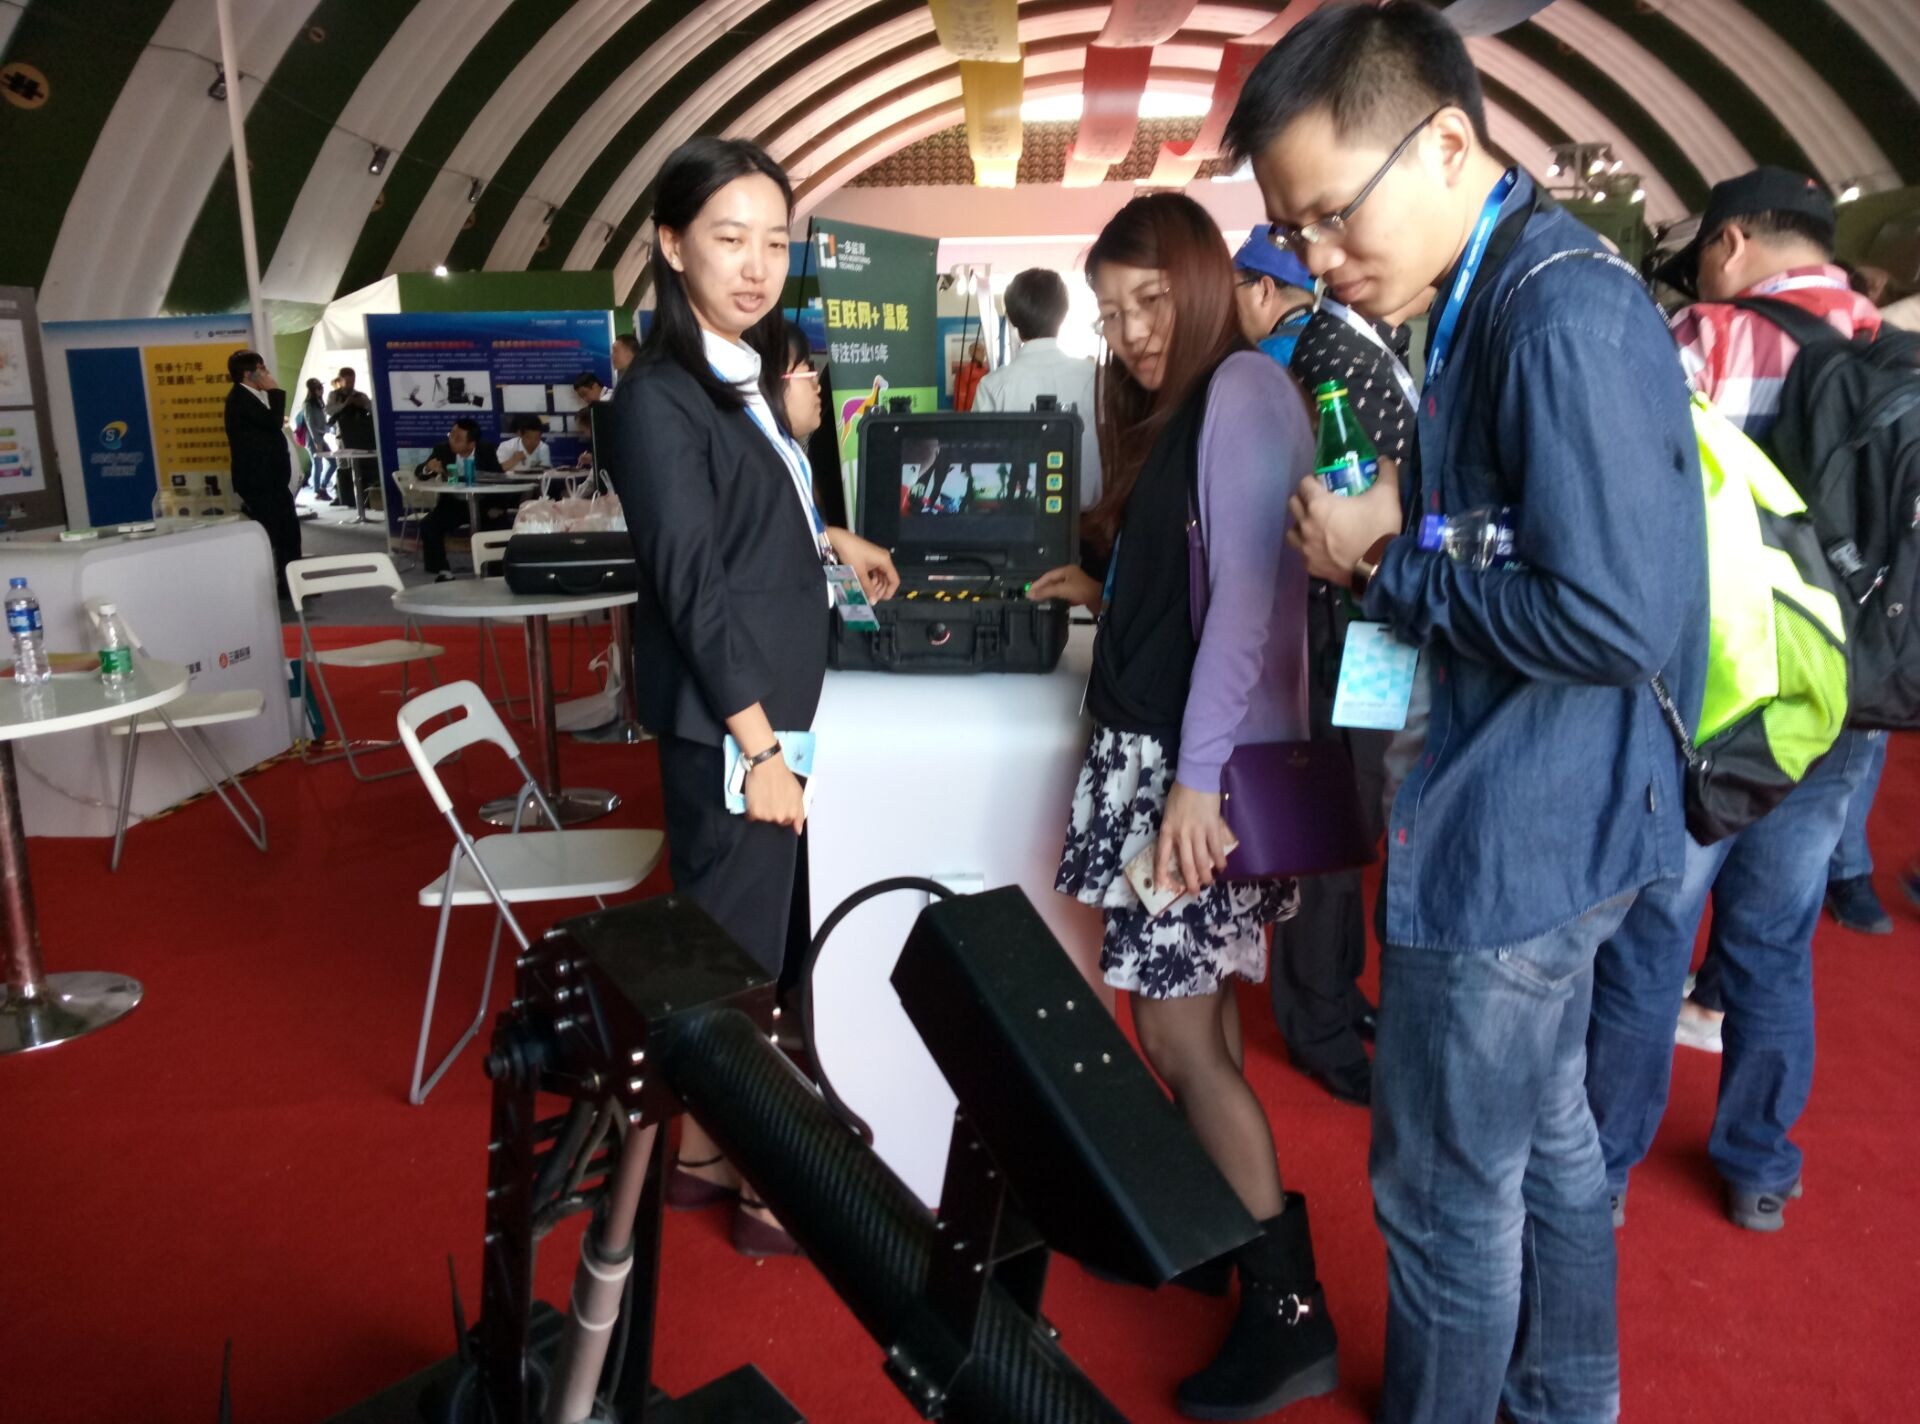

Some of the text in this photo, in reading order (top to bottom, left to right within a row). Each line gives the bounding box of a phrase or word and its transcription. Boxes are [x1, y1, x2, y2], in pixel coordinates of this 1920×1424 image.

[830, 341, 889, 364] 专注行业15年
